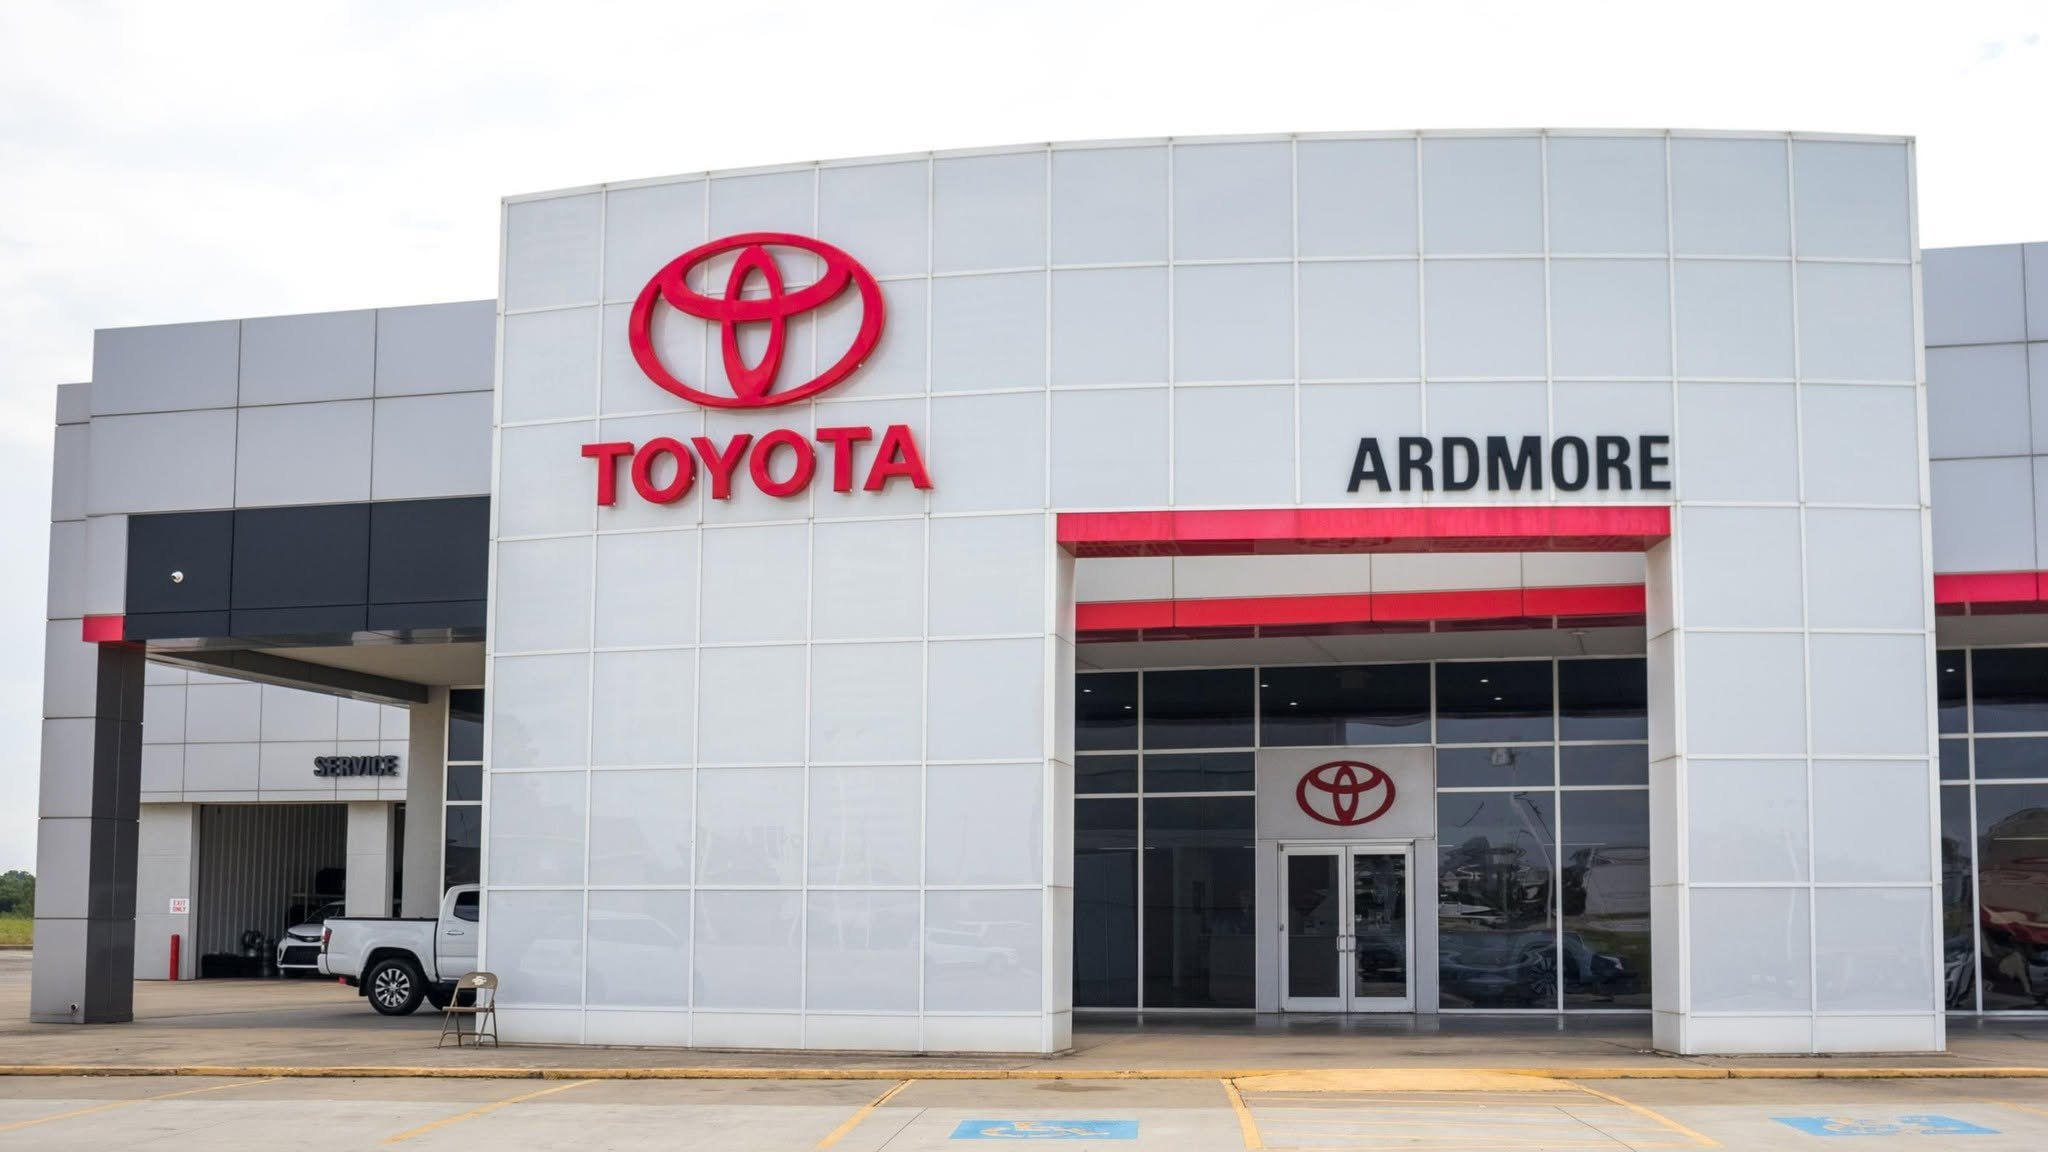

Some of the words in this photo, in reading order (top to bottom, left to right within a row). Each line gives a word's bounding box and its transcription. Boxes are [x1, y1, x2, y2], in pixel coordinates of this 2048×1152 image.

[581, 424, 933, 506] TOYOTA
[1347, 435, 1671, 492] ARDMORE
[313, 756, 399, 777] SERVICE
